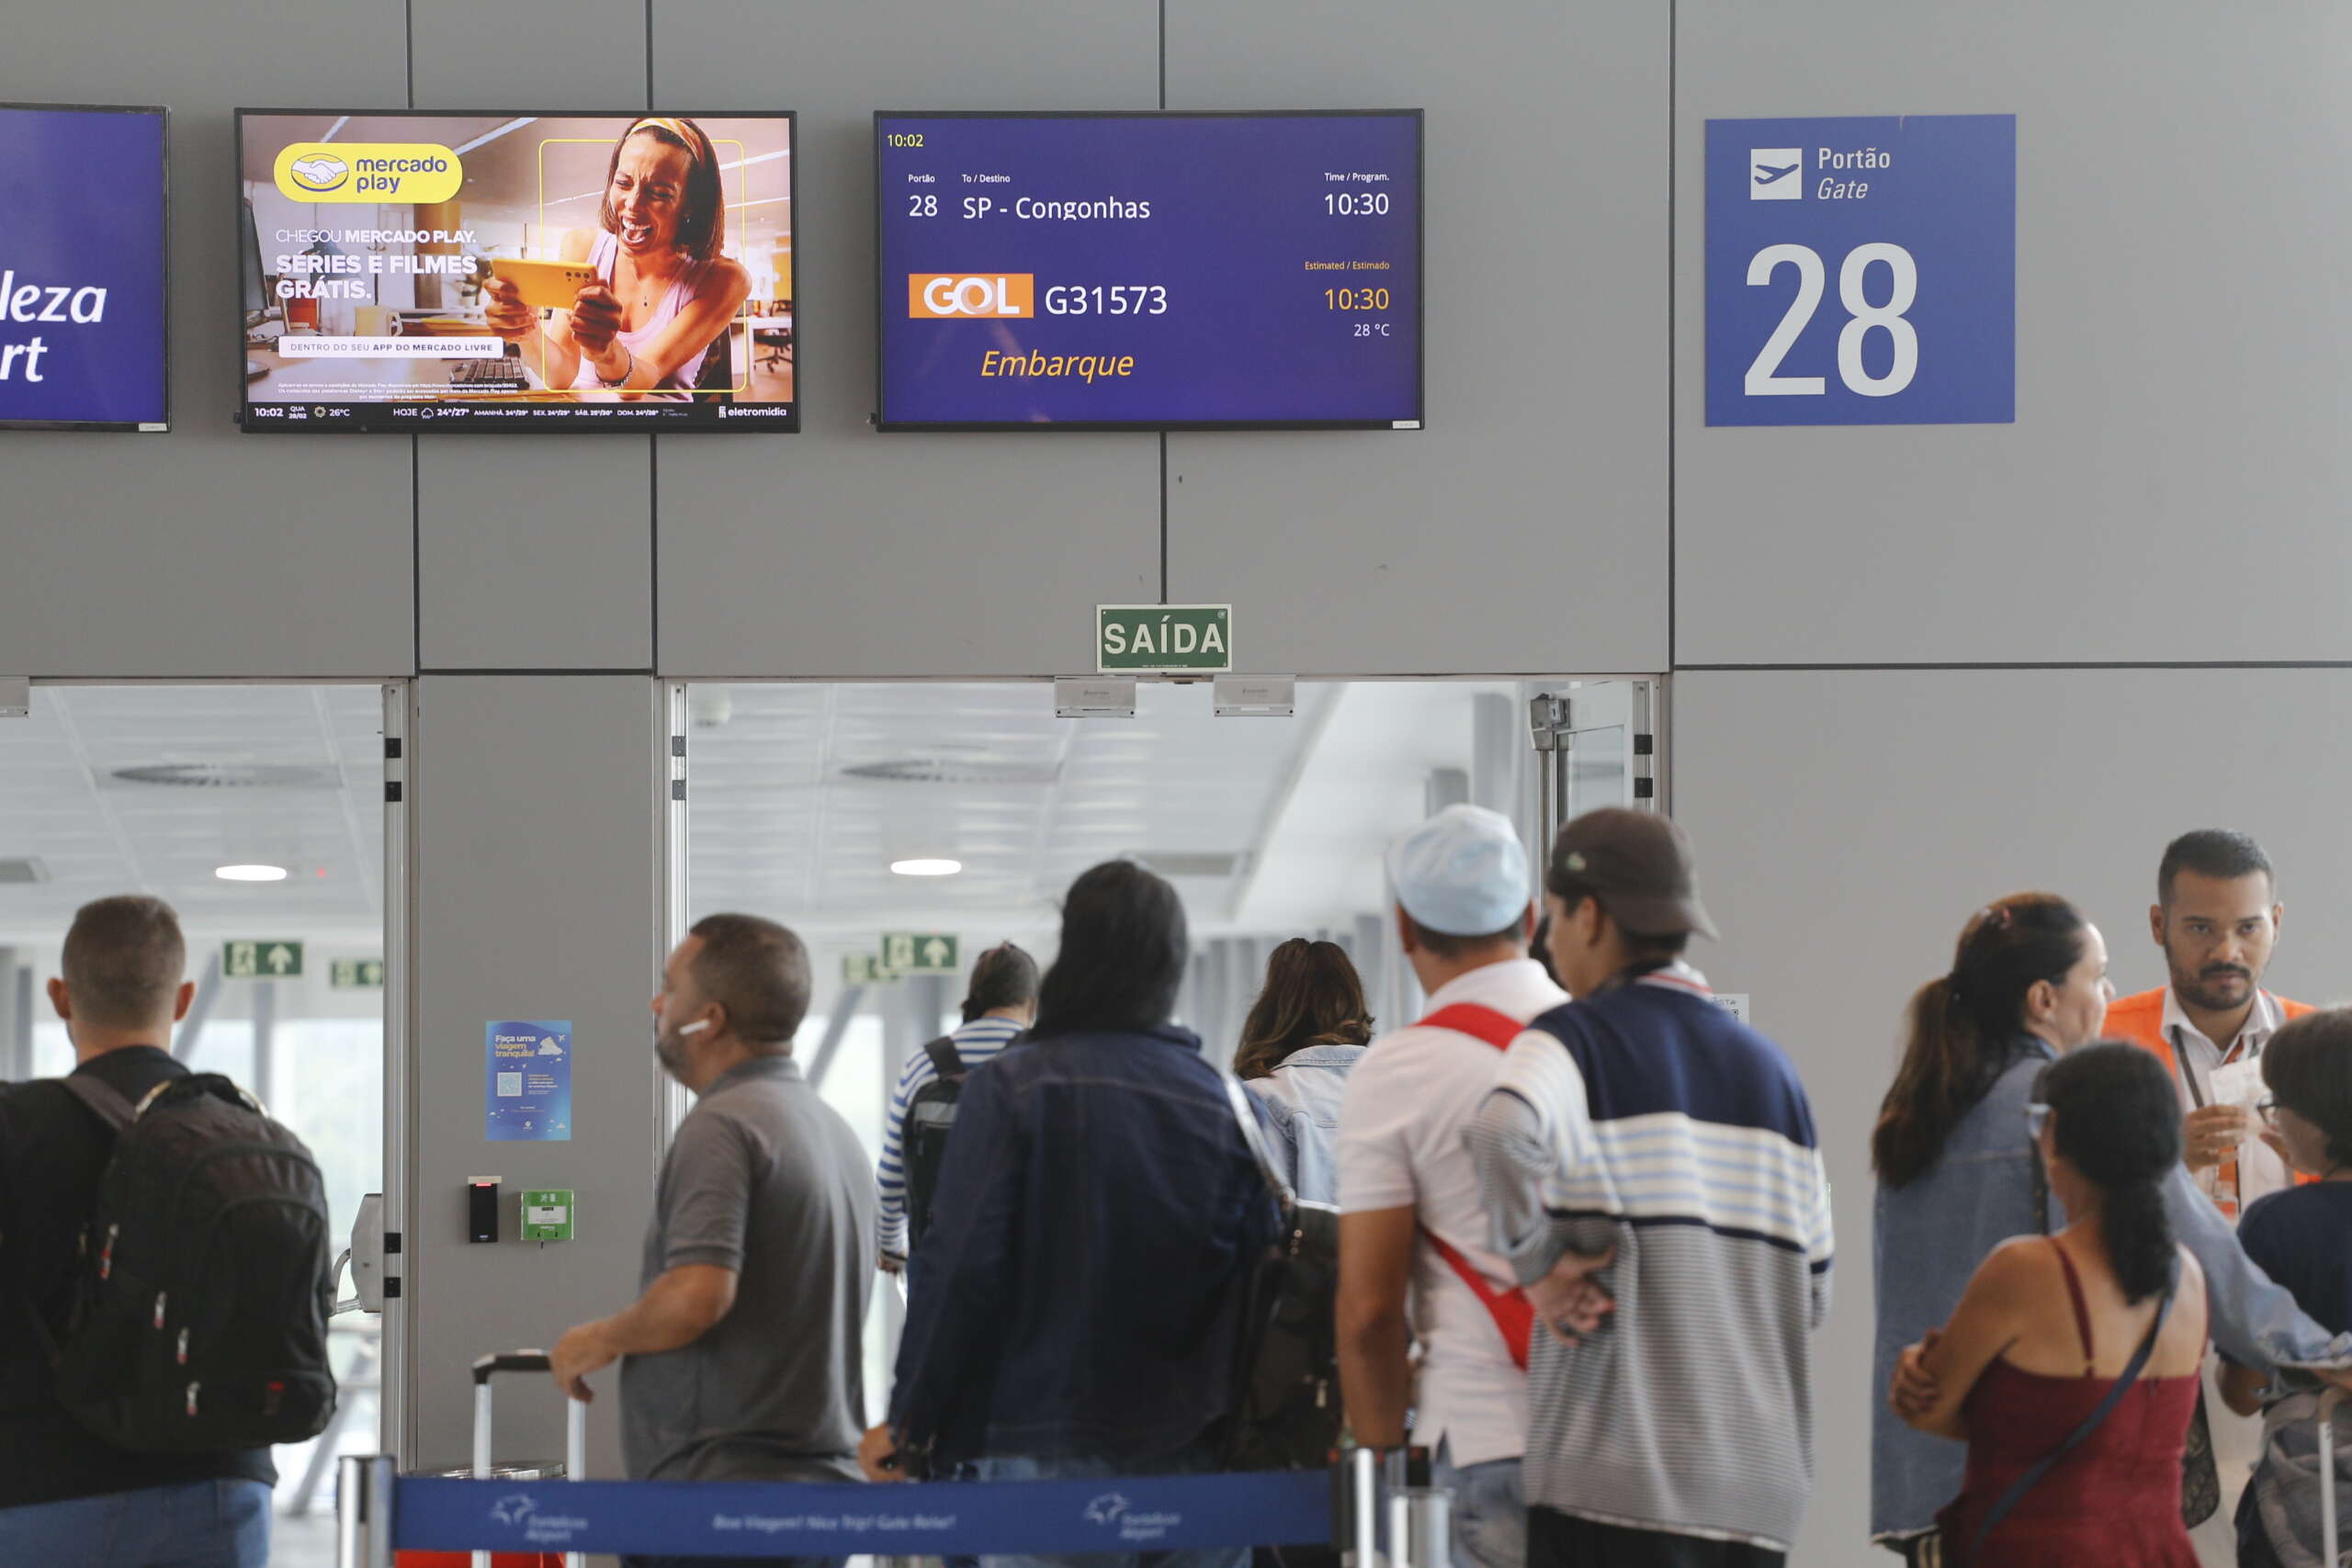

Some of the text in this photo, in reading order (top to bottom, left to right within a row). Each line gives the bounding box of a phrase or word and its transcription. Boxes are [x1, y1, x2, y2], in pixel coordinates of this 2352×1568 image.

[887, 134, 924, 147] 10:02
[356, 156, 447, 173] mercado
[1817, 147, 1891, 170] Portão
[356, 174, 401, 194] play
[908, 173, 935, 184] Portão
[962, 174, 972, 183] To
[979, 173, 1011, 184] Destino
[1324, 173, 1345, 182] Time
[1352, 173, 1390, 184] Program.
[1816, 177, 1869, 199] Gate
[909, 195, 938, 218] 28
[963, 197, 992, 219] SP
[1015, 196, 1150, 220] Congonhas
[1325, 193, 1389, 216] 10:30
[276, 230, 476, 243] CHEGOU MERCADO PLAY.
[276, 250, 478, 274] SÉRIES E FILMES
[1305, 262, 1344, 270] Estimated
[1352, 262, 1389, 270] Estimado
[276, 276, 371, 299] GRÁTIS.
[923, 276, 1020, 315] GOL
[1045, 286, 1168, 315] G31573
[1325, 288, 1389, 310] 10:30
[1354, 324, 1370, 336] 28
[1744, 242, 1919, 398] 28
[290, 343, 493, 353] DENTRO DO SEU APP DO MERCADO LIVRE
[980, 350, 1134, 383] Embarque
[254, 407, 284, 418] 10:02
[728, 407, 787, 417] eletromidia
[1104, 615, 1225, 654] SAÍDA
[495, 1035, 515, 1043] Faça
